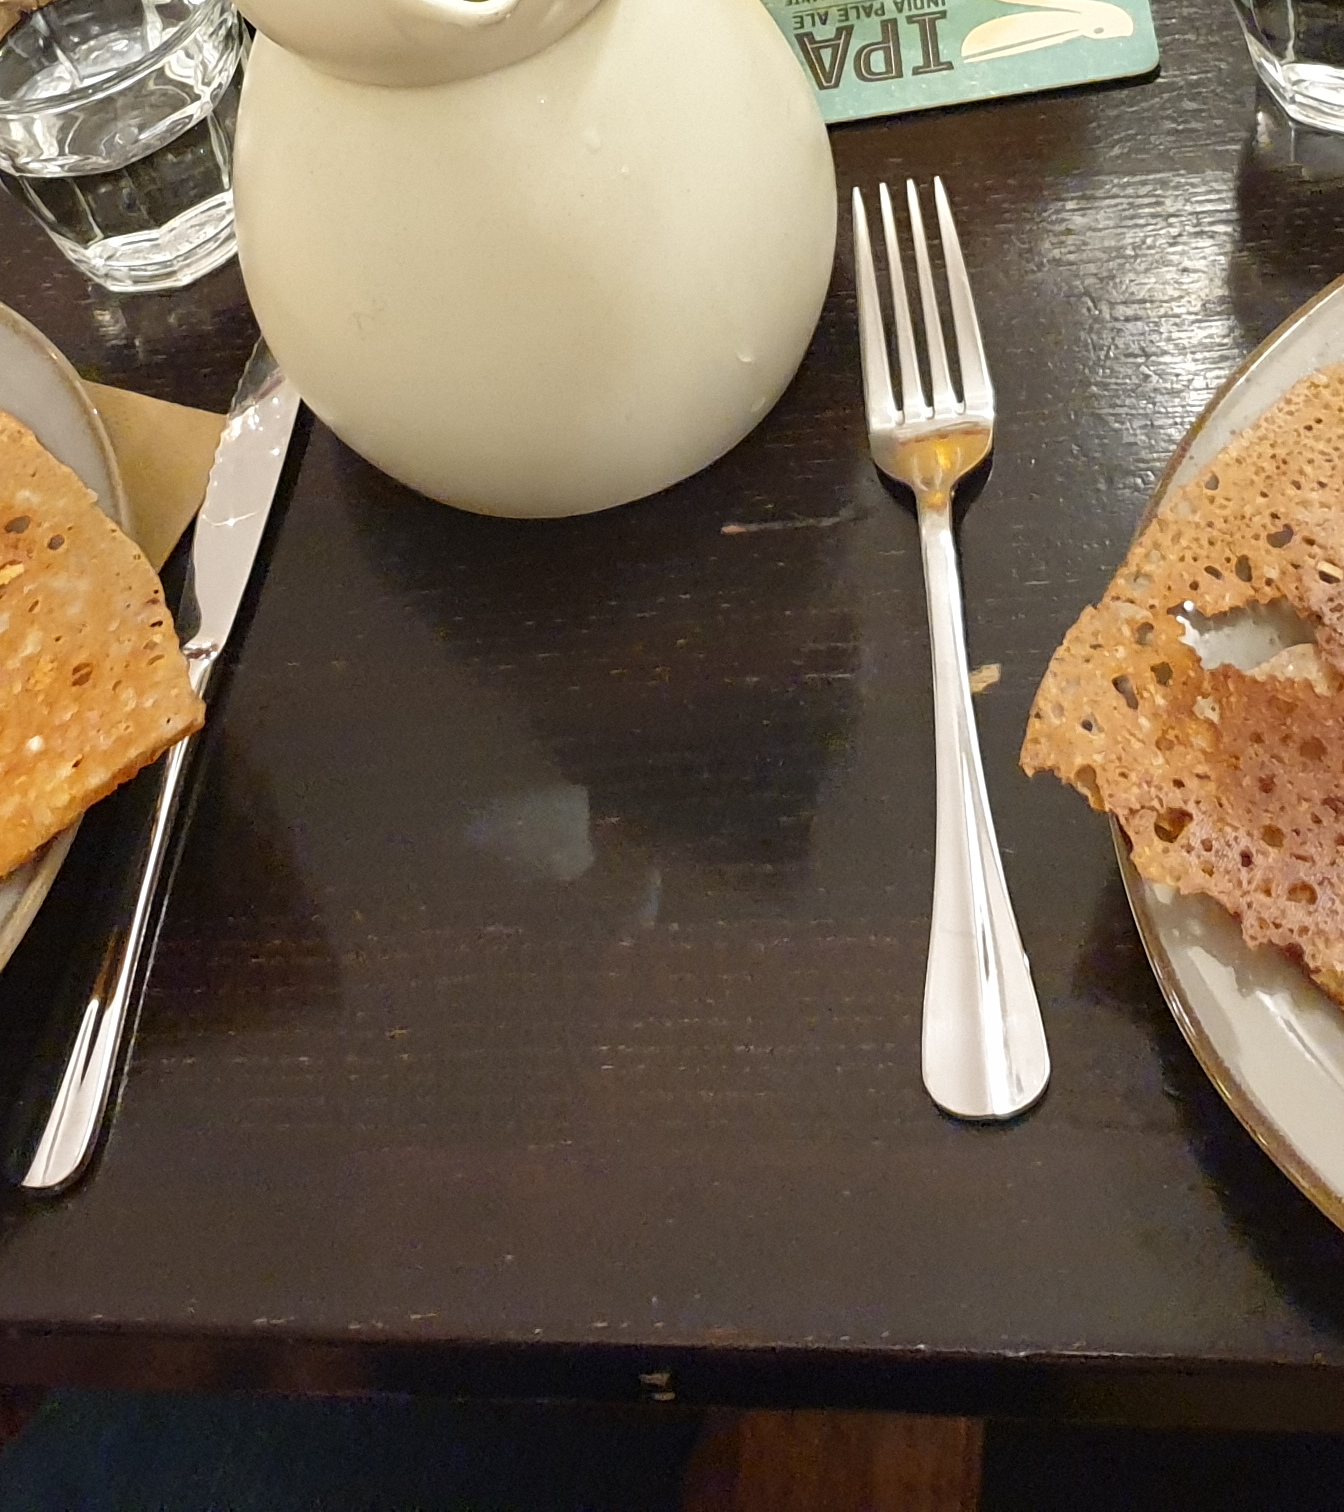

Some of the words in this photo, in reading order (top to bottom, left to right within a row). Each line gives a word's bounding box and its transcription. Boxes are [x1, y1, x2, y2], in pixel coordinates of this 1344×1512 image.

[792, 10, 830, 30] ALE
[837, 1, 886, 23] PALE
[794, 9, 955, 91] IPA
